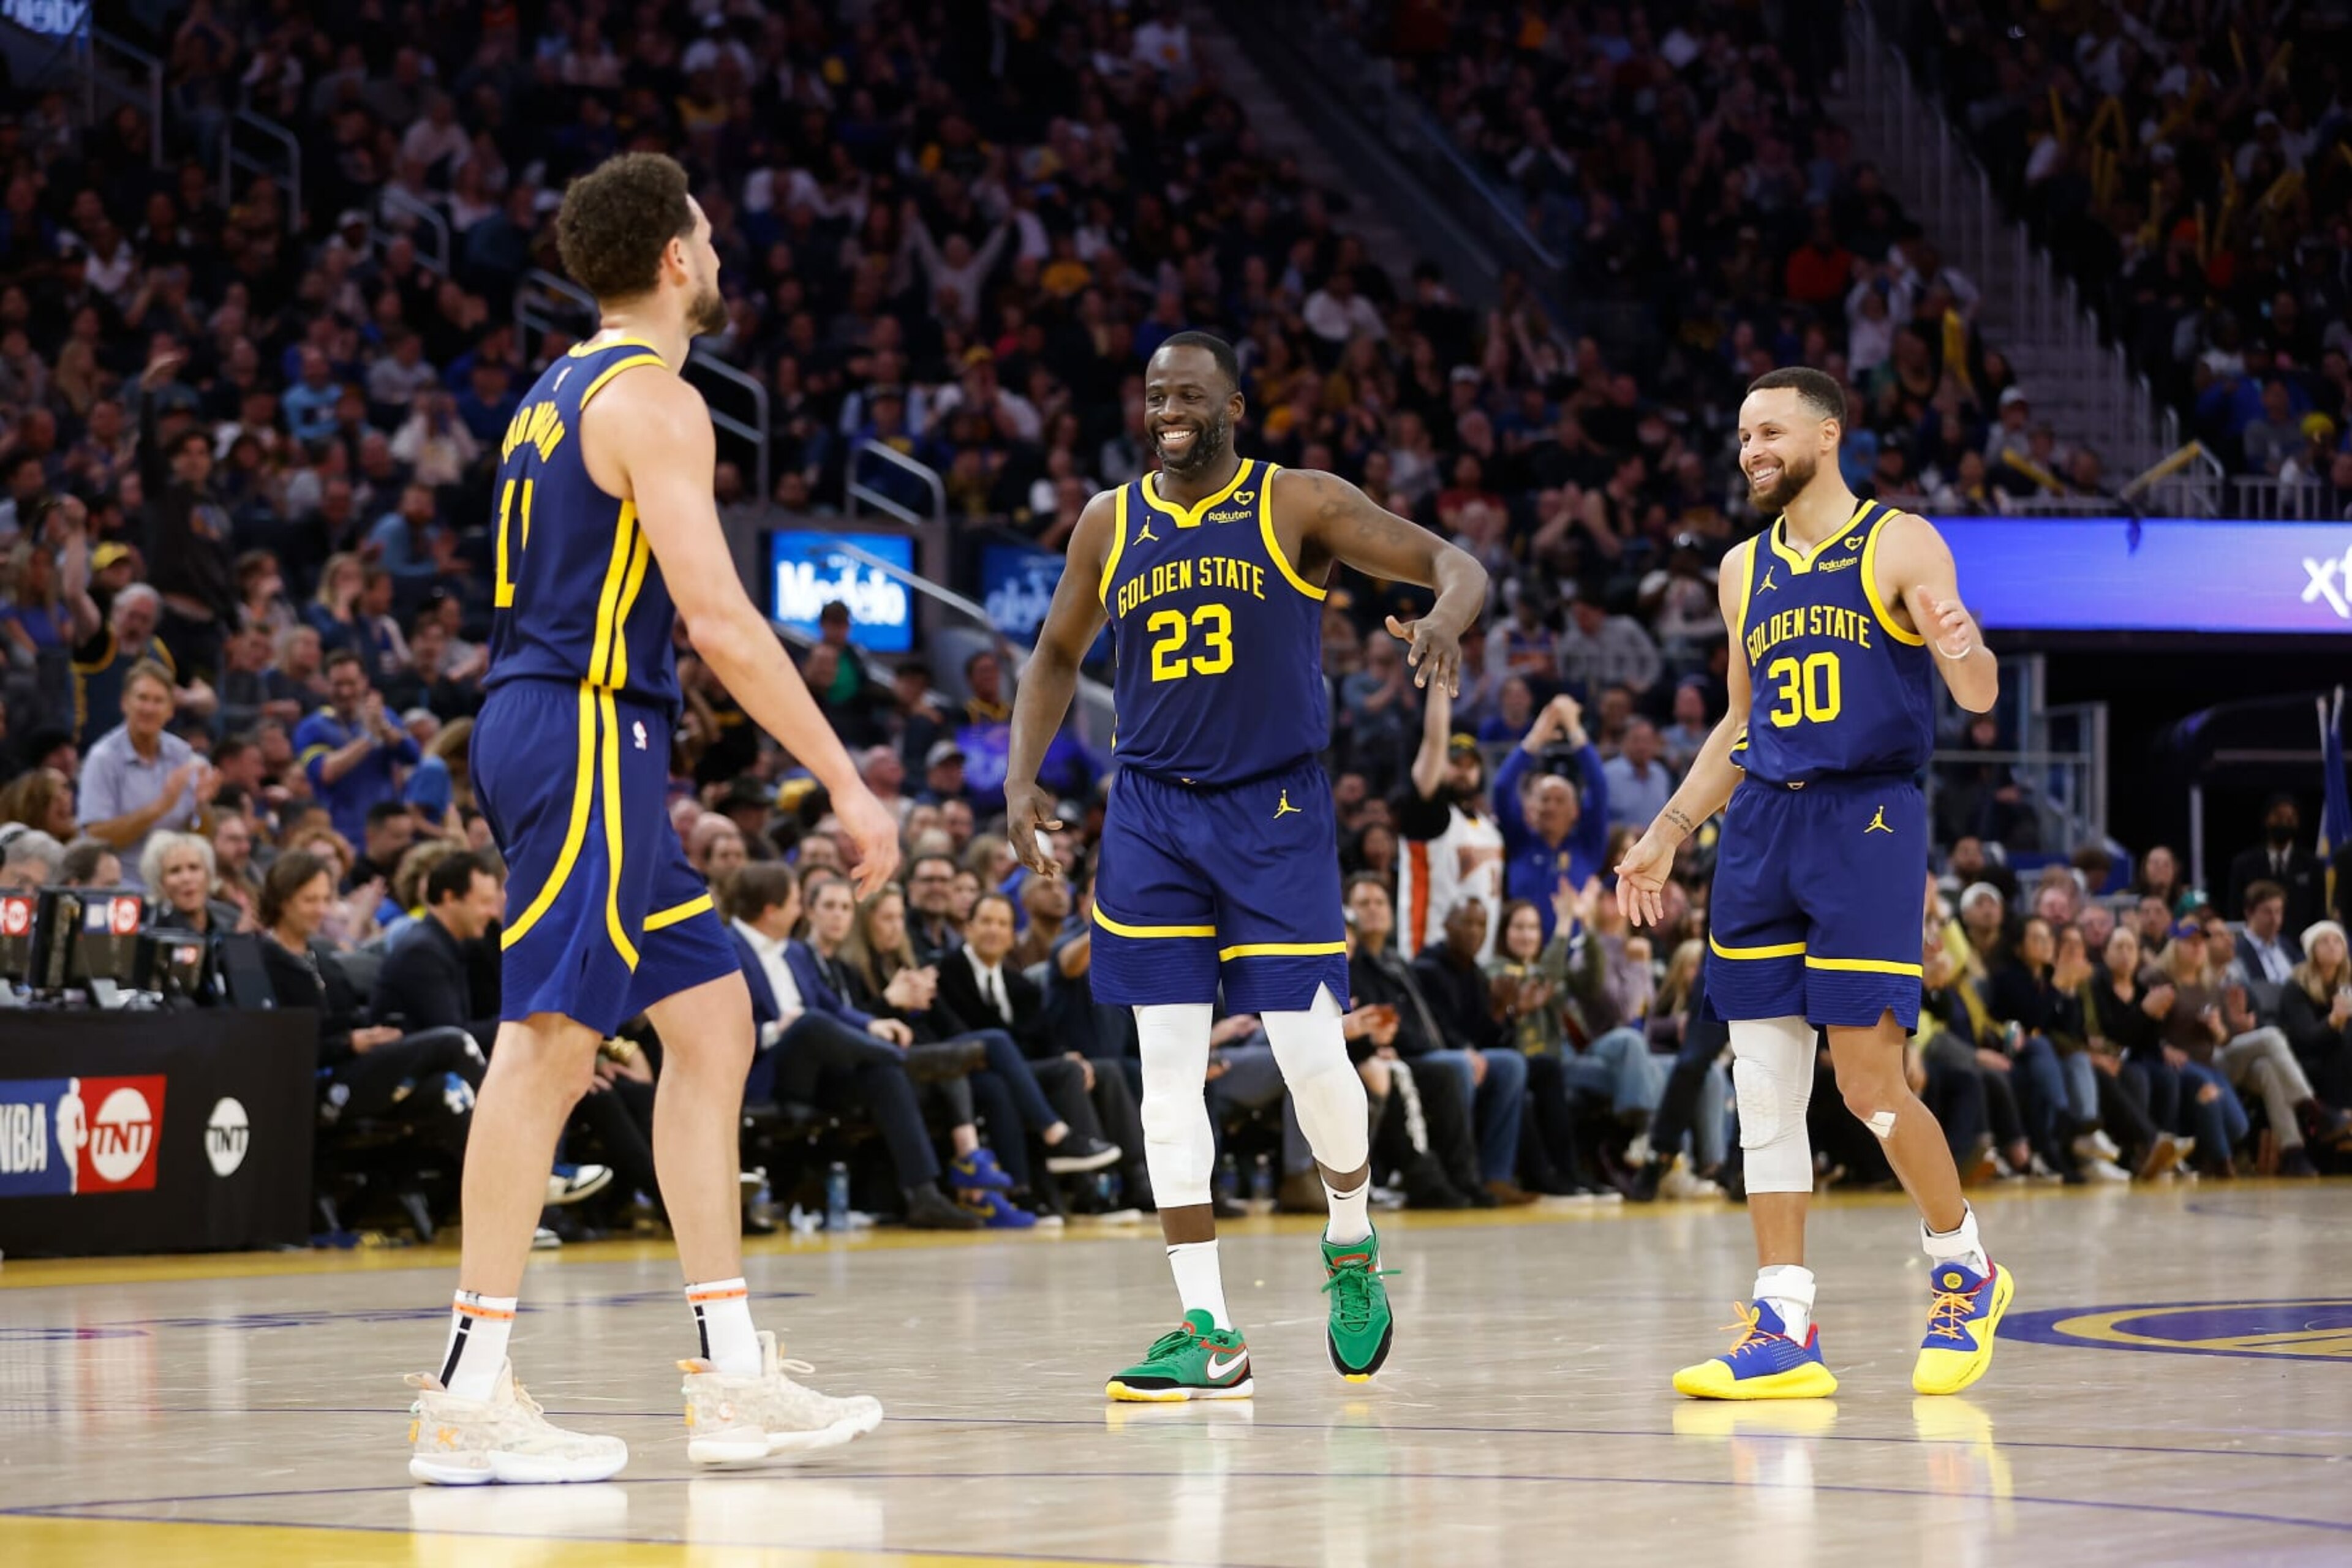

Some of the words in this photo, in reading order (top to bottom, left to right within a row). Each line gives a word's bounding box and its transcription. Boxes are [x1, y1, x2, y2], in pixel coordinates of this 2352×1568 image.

[1208, 510, 1253, 524] Rakuten
[1117, 559, 1193, 619] GOLDEN
[1199, 556, 1266, 601] STATE
[1818, 557, 1858, 573] Rakuten
[1147, 603, 1234, 682] 23
[1746, 607, 1806, 667] GOLDEN
[1809, 605, 1871, 649] STATE
[1768, 651, 1841, 728] 30
[0, 1102, 48, 1173] NBA
[93, 1120, 152, 1155] TNT
[208, 1125, 250, 1153] TNT
